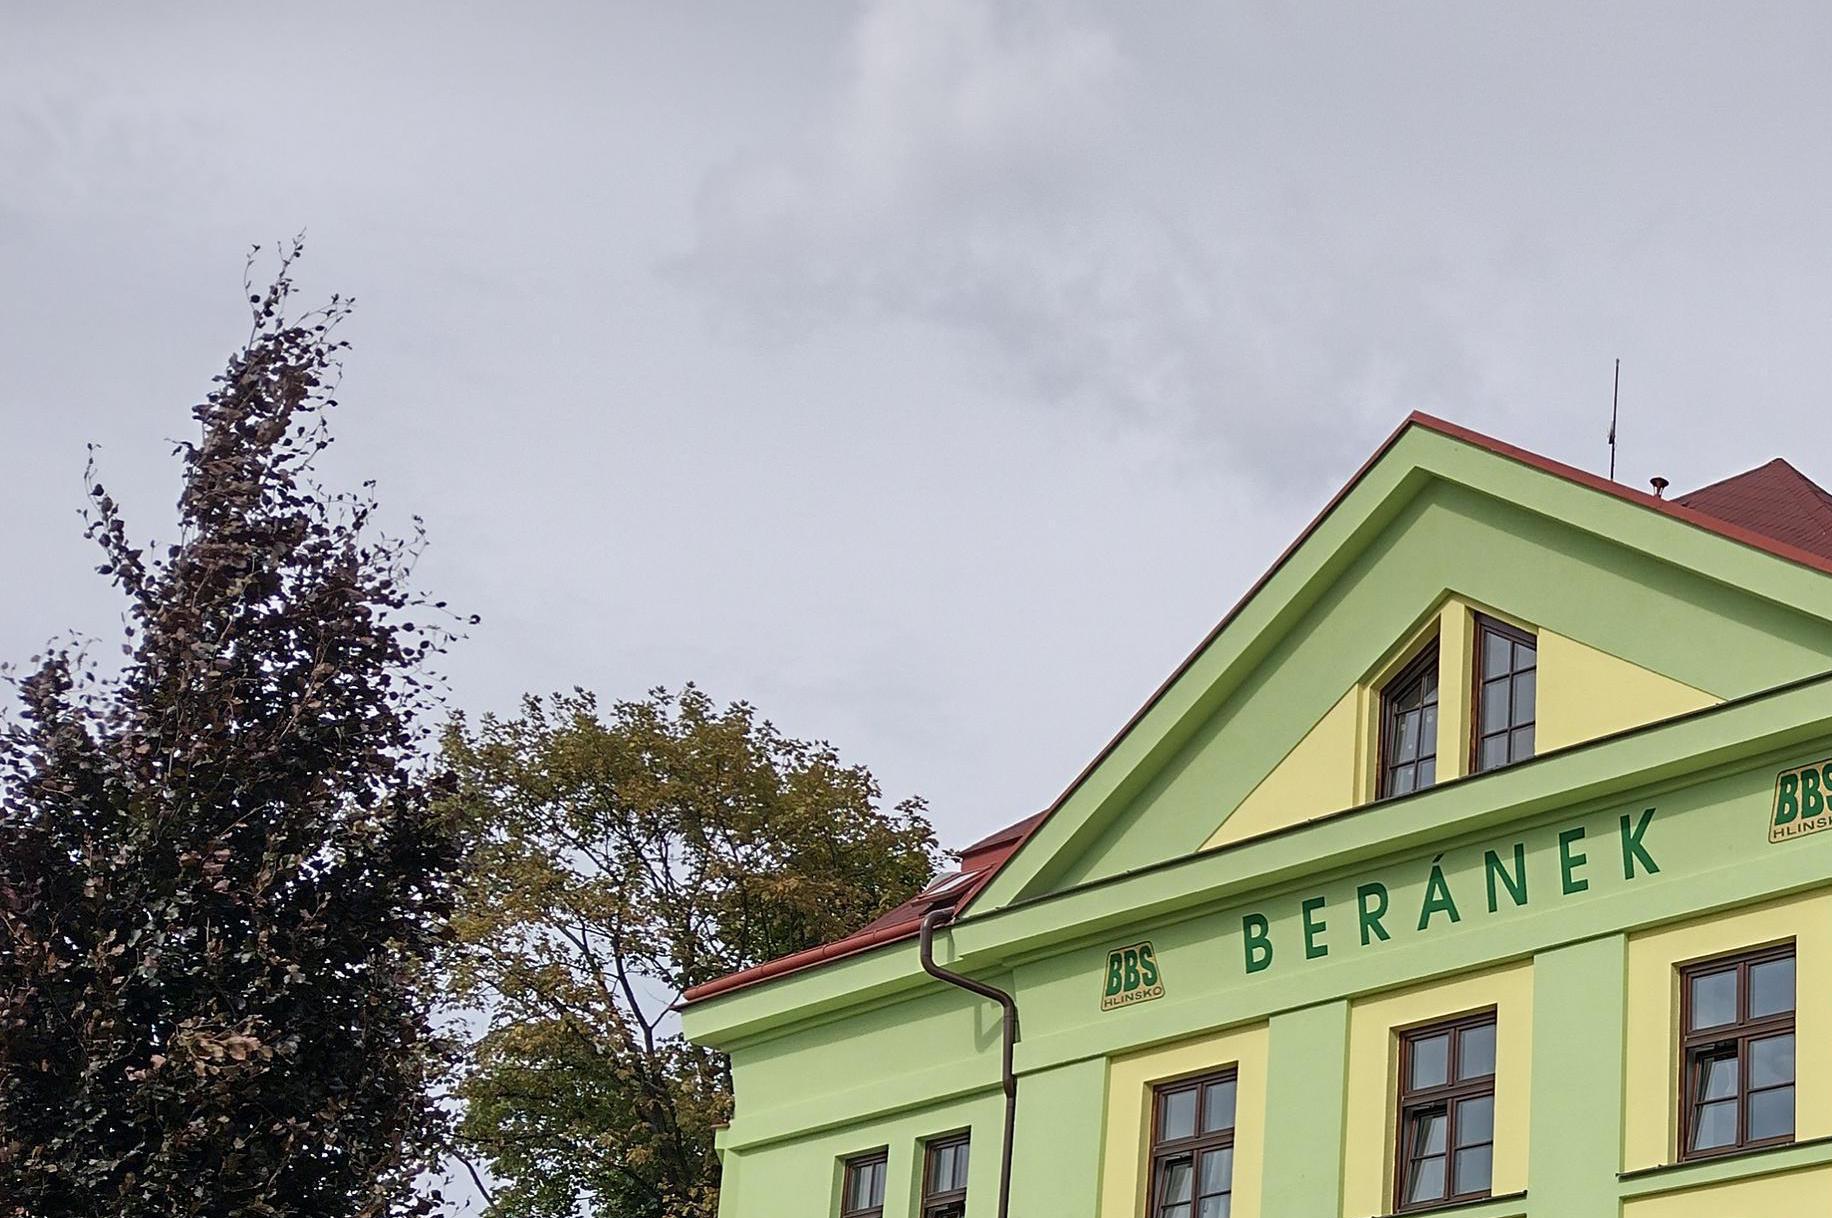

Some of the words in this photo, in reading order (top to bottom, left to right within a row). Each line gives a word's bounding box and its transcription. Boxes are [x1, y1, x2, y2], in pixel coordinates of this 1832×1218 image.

[1242, 807, 1661, 974] BERÁNEK
[1104, 986, 1162, 1007] HLINSKO
[1105, 945, 1158, 997] BBS
